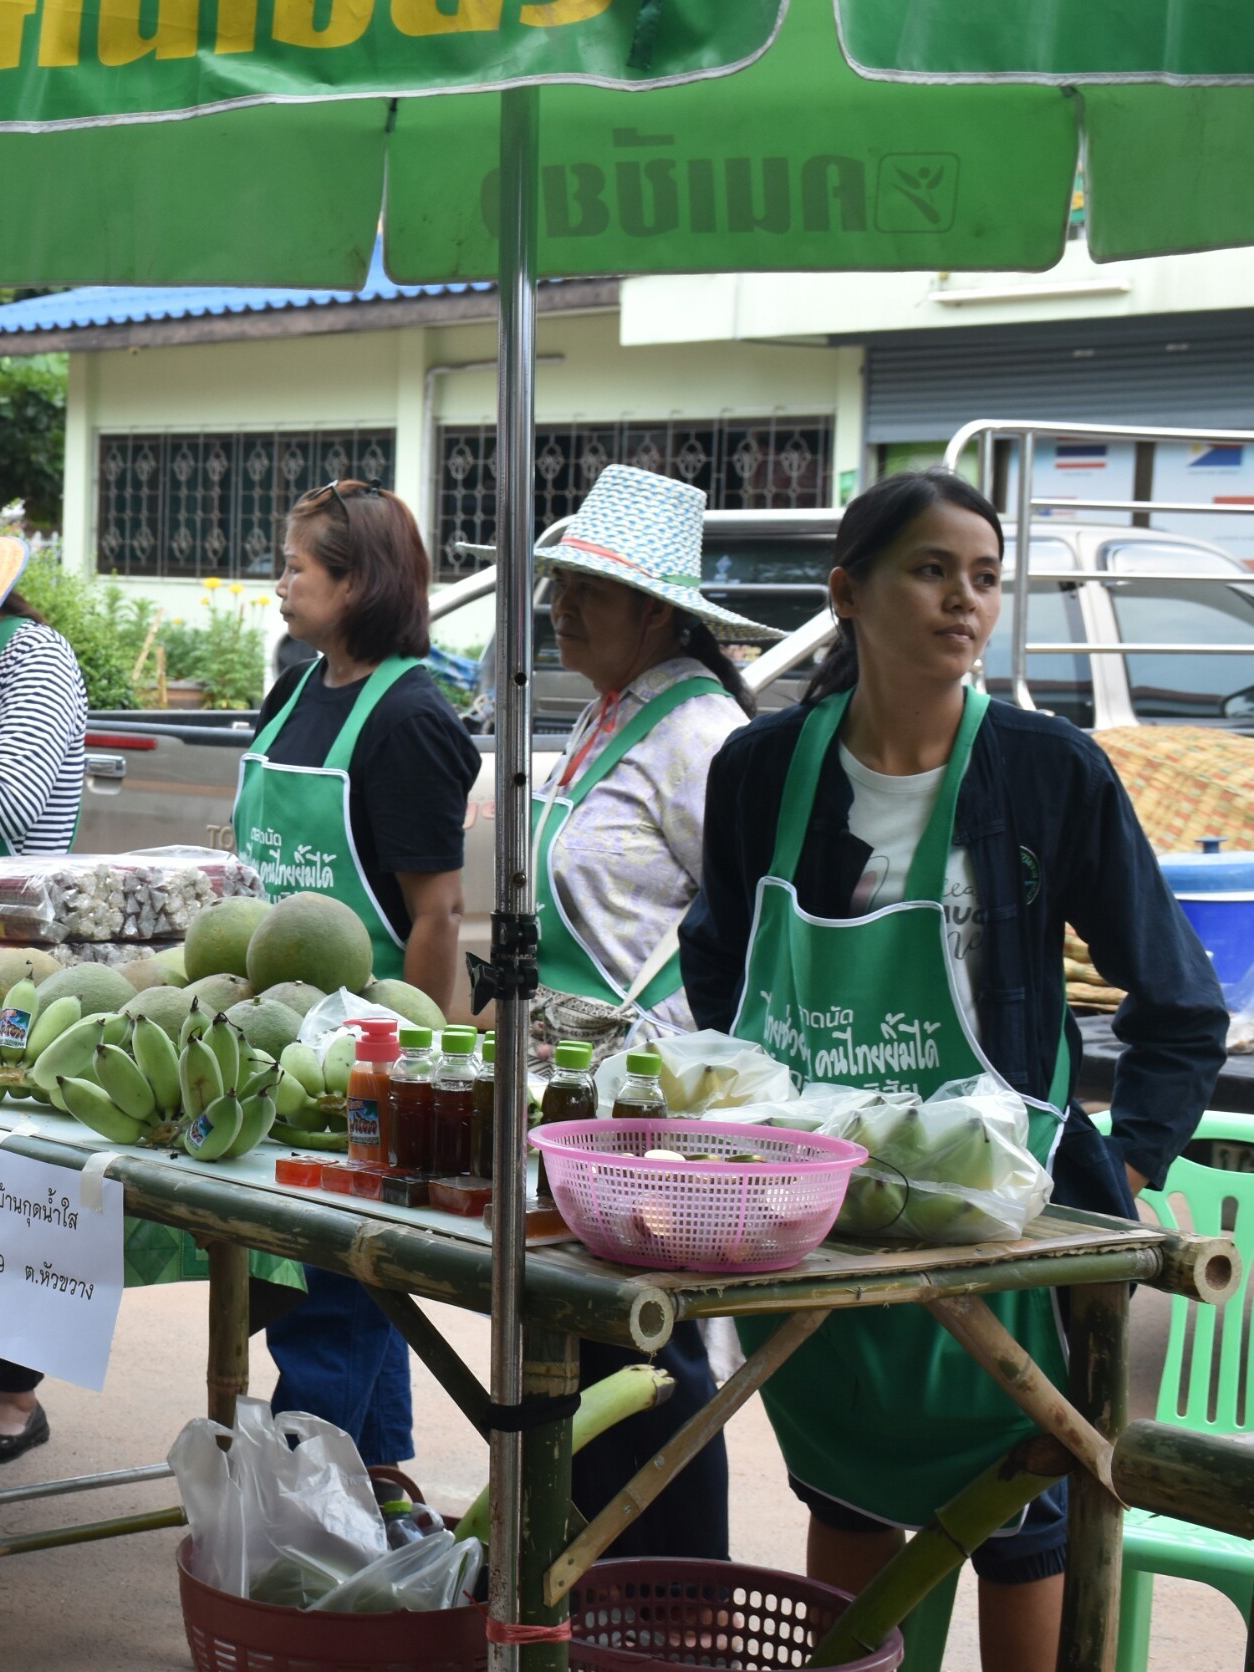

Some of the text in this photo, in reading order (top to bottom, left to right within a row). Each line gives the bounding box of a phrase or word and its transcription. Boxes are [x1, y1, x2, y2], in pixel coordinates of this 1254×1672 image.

[801, 1005, 854, 1028] าดนัด
[815, 1012, 941, 1077] คนไทยยิ้มได้
[24, 1262, 95, 1300] ต.หัวขวาง
